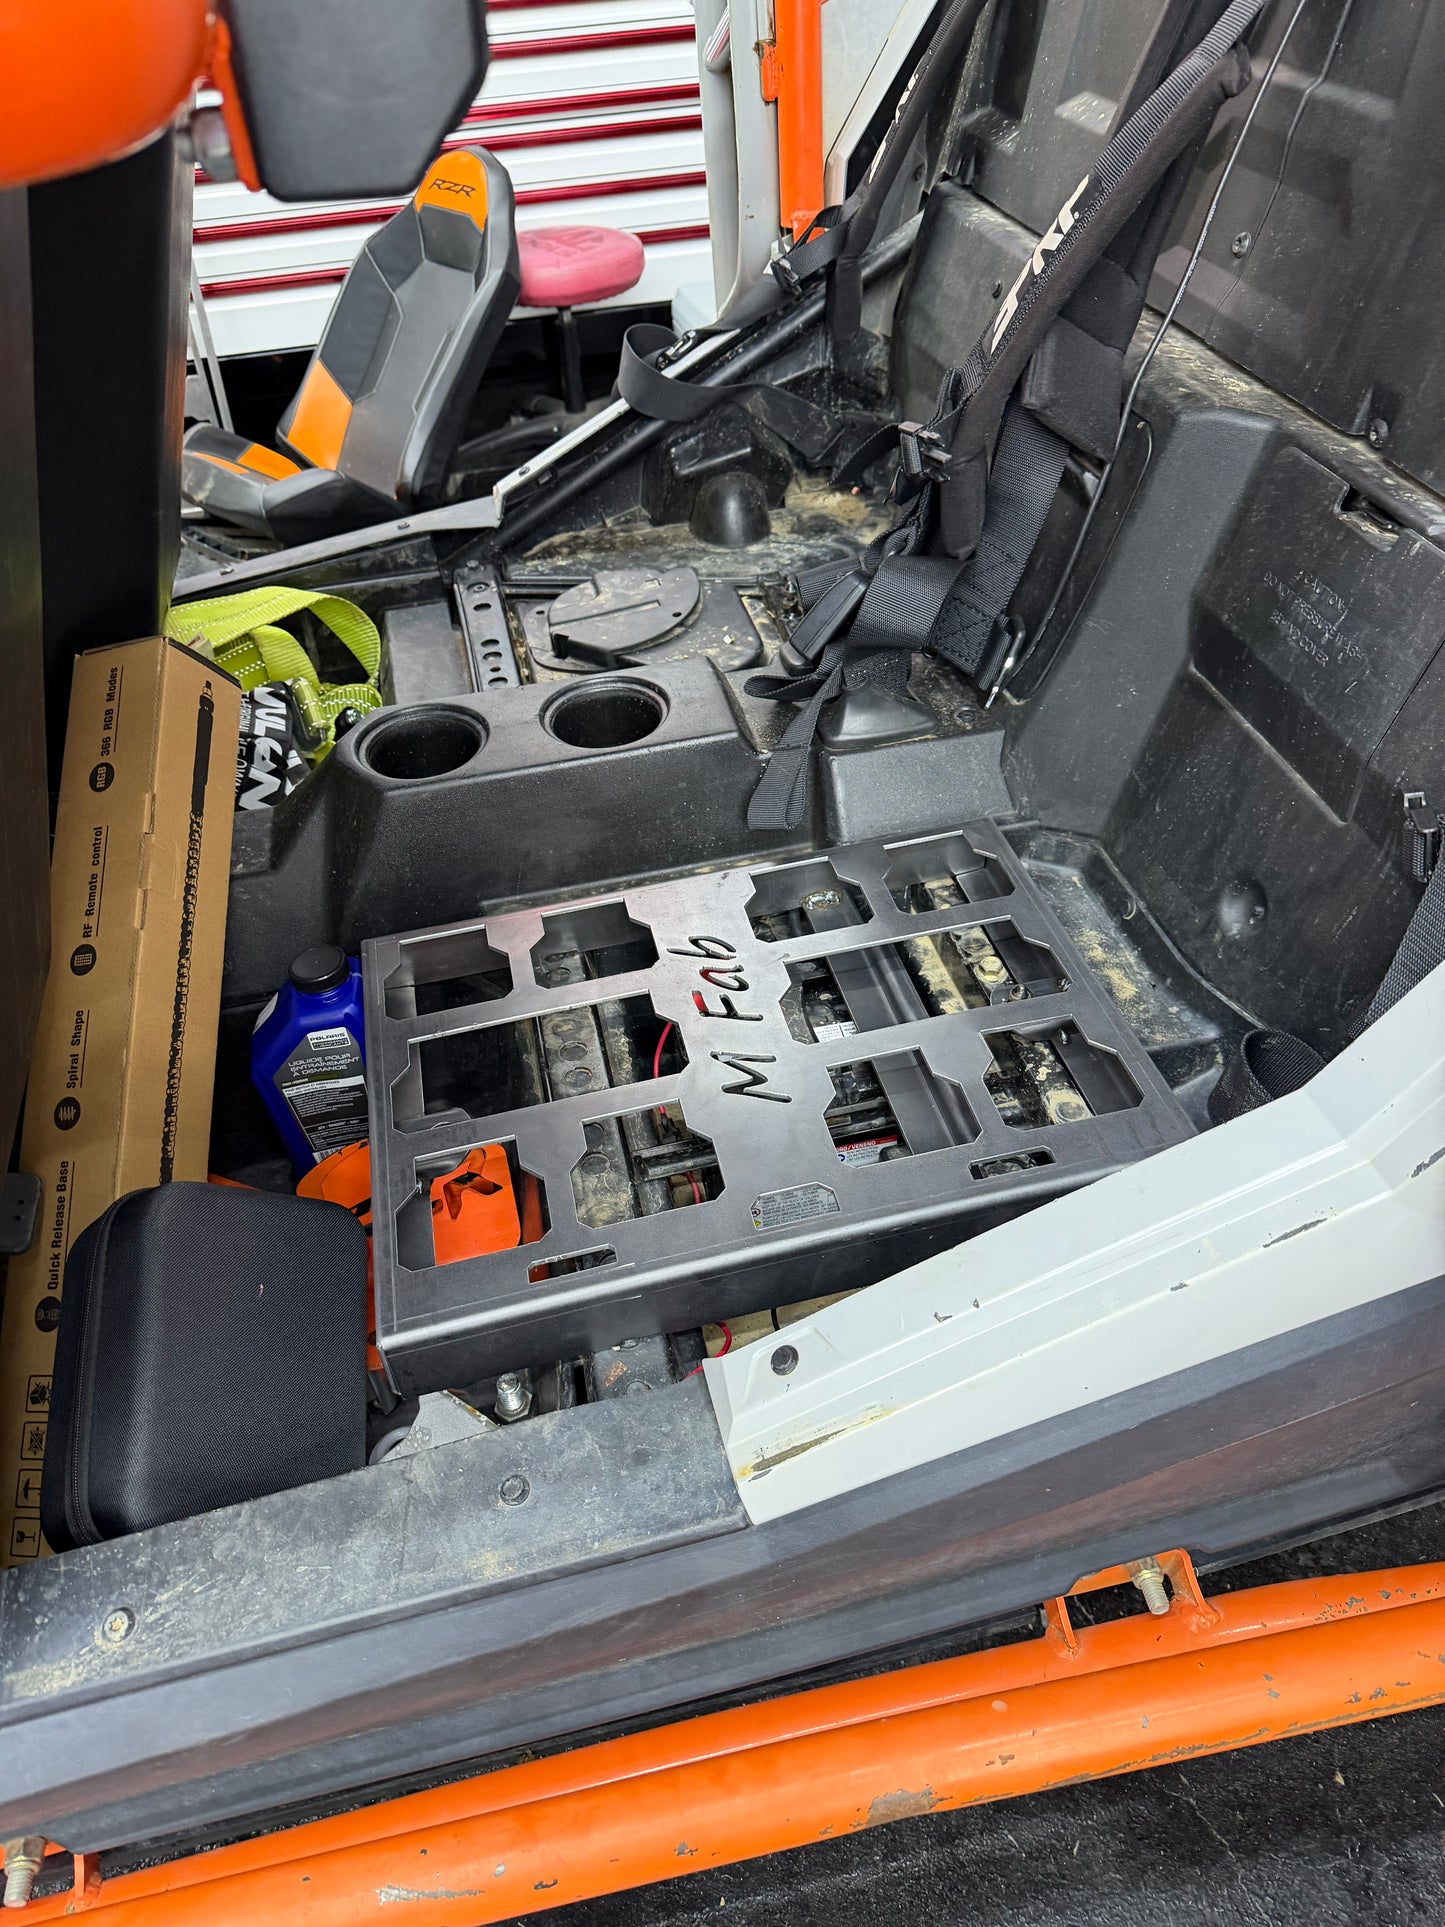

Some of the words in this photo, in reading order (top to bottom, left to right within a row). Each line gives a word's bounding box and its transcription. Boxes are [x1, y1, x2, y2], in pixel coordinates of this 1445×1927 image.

[429, 178, 476, 198] RZR
[106, 667, 118, 702] Modes
[103, 708, 114, 731] RGB
[101, 736, 111, 757] 366
[96, 766, 107, 788] RGB
[92, 826, 103, 867] control
[85, 873, 98, 917] Remote
[83, 923, 93, 938] RF
[666, 936, 764, 1021] Fab
[71, 1010, 84, 1046] Shape
[66, 1053, 79, 1089] Spiral
[302, 1065, 347, 1075] DEMANDE
[325, 1053, 350, 1061] POUR
[710, 1051, 792, 1103] M
[56, 1161, 69, 1193] Base
[51, 1196, 66, 1249] Release
[47, 1252, 61, 1290] Quick
